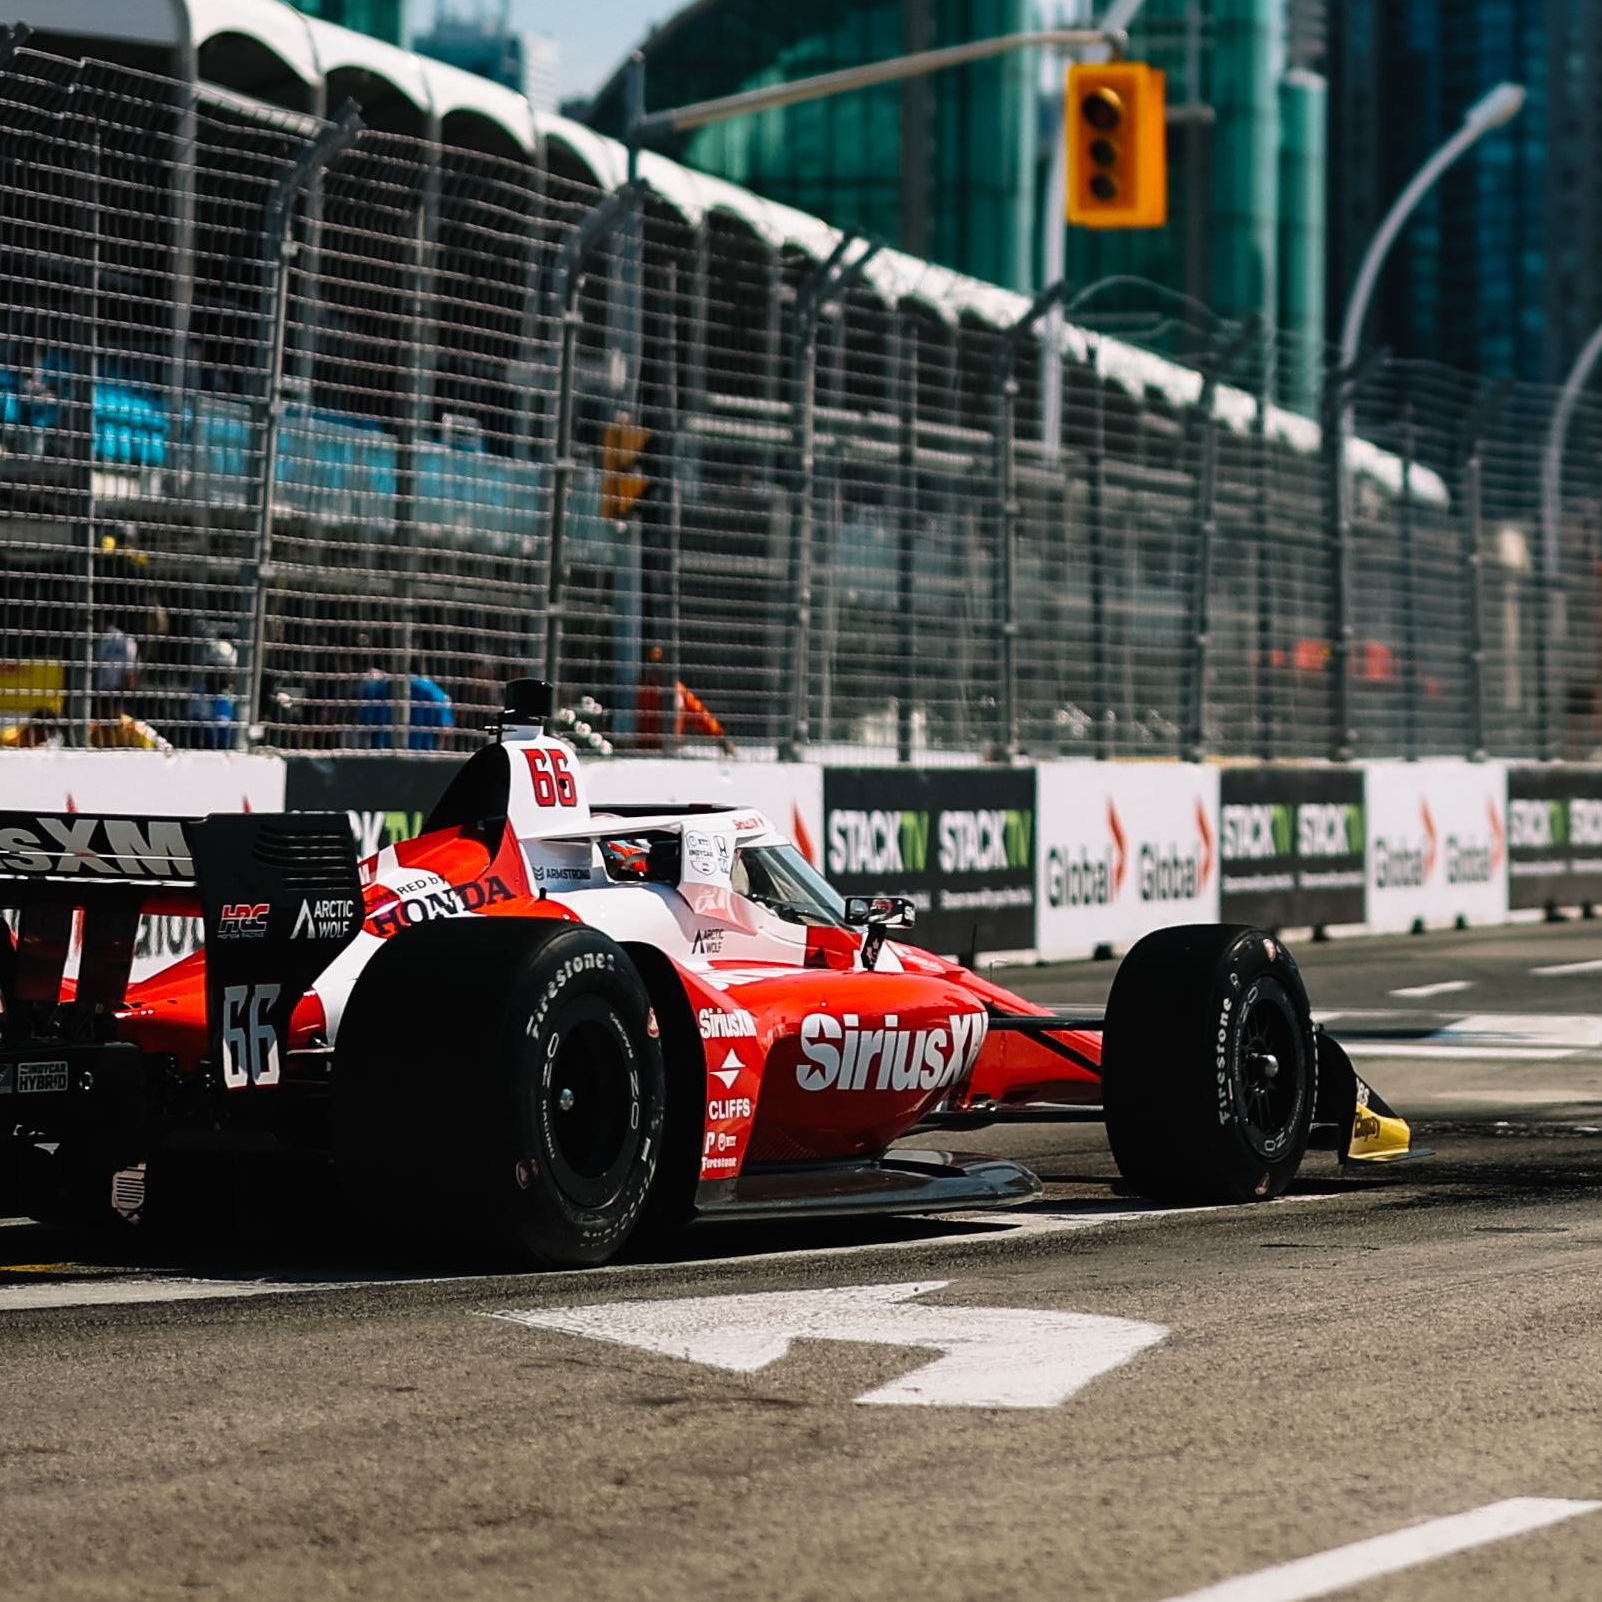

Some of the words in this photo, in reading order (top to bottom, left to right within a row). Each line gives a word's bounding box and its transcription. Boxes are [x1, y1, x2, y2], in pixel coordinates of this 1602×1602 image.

[521, 748, 577, 808] 66
[829, 809, 930, 874] STACKTV
[939, 809, 1031, 873] STACKTV
[1374, 836, 1424, 889] Global
[546, 867, 592, 881] ARMSTRONG
[1047, 845, 1112, 909] Global
[1138, 841, 1201, 902] Global
[313, 900, 354, 918] ARCTIC
[318, 921, 350, 939] WOLF
[374, 875, 517, 935] HONDA
[703, 928, 724, 940] ARCTIC
[706, 941, 722, 954] WOLF
[526, 952, 606, 1040] Firestone
[222, 983, 281, 1088] 66
[1216, 997, 1233, 1126] Firestone
[19, 1074, 67, 1091] HYBRID
[708, 1097, 751, 1120] CLIFFS
[701, 1156, 737, 1172] Firestone
